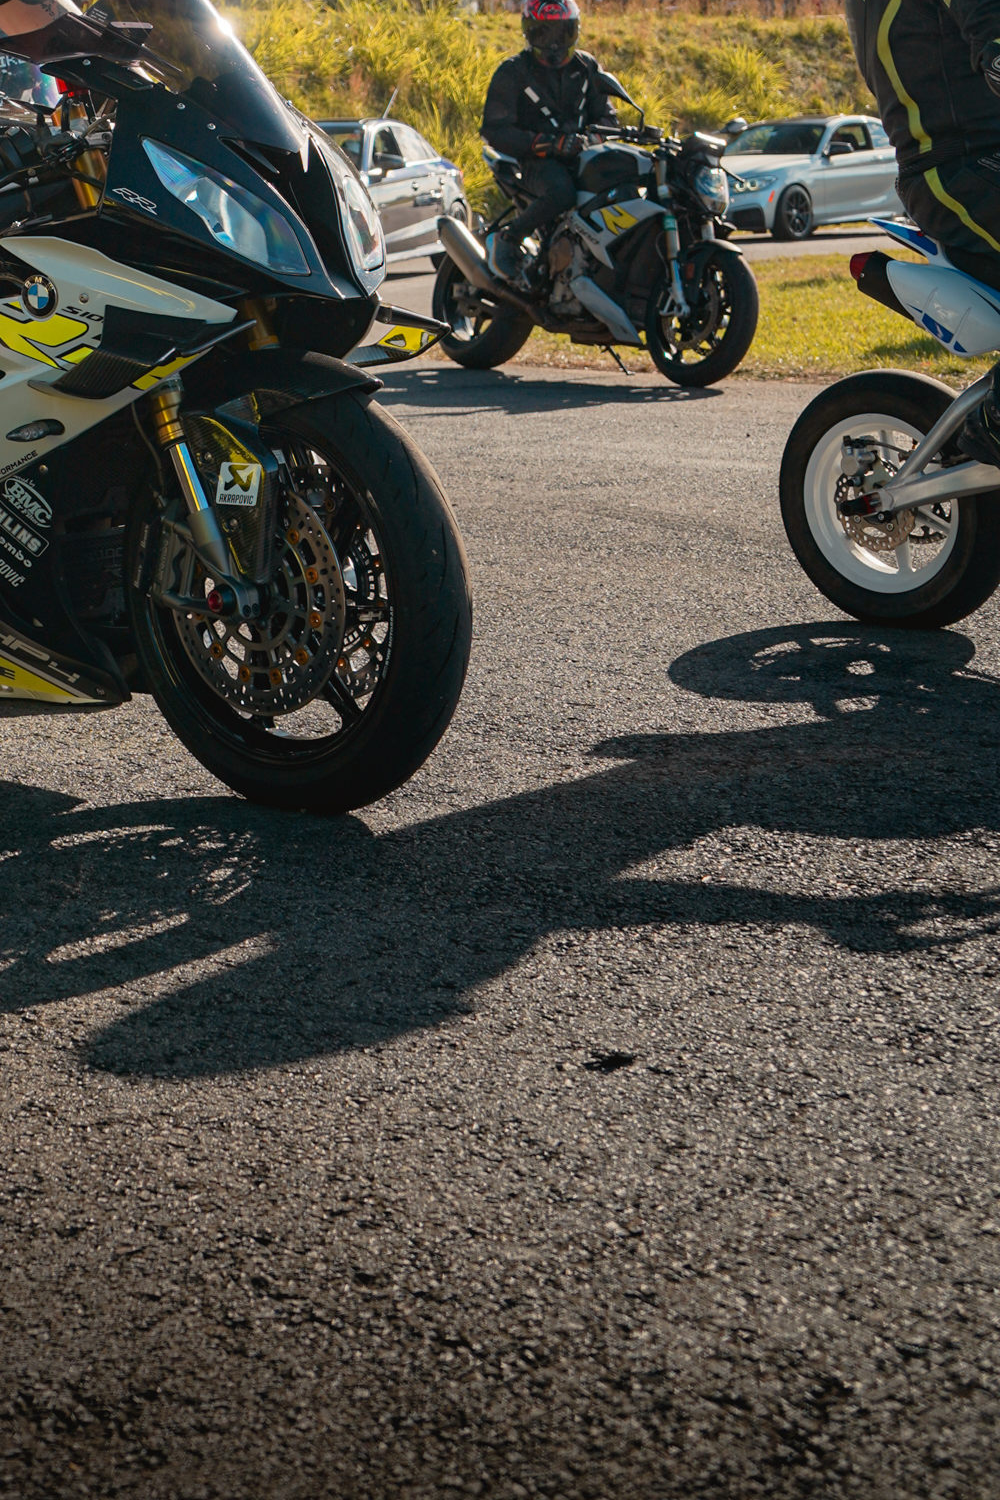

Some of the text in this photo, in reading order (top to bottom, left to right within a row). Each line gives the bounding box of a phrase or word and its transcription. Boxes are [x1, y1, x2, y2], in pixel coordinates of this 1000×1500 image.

[112, 187, 158, 216] RR
[24, 276, 55, 290] BMW
[2, 492, 40, 526] Air Filter
[10, 481, 51, 524] BMC
